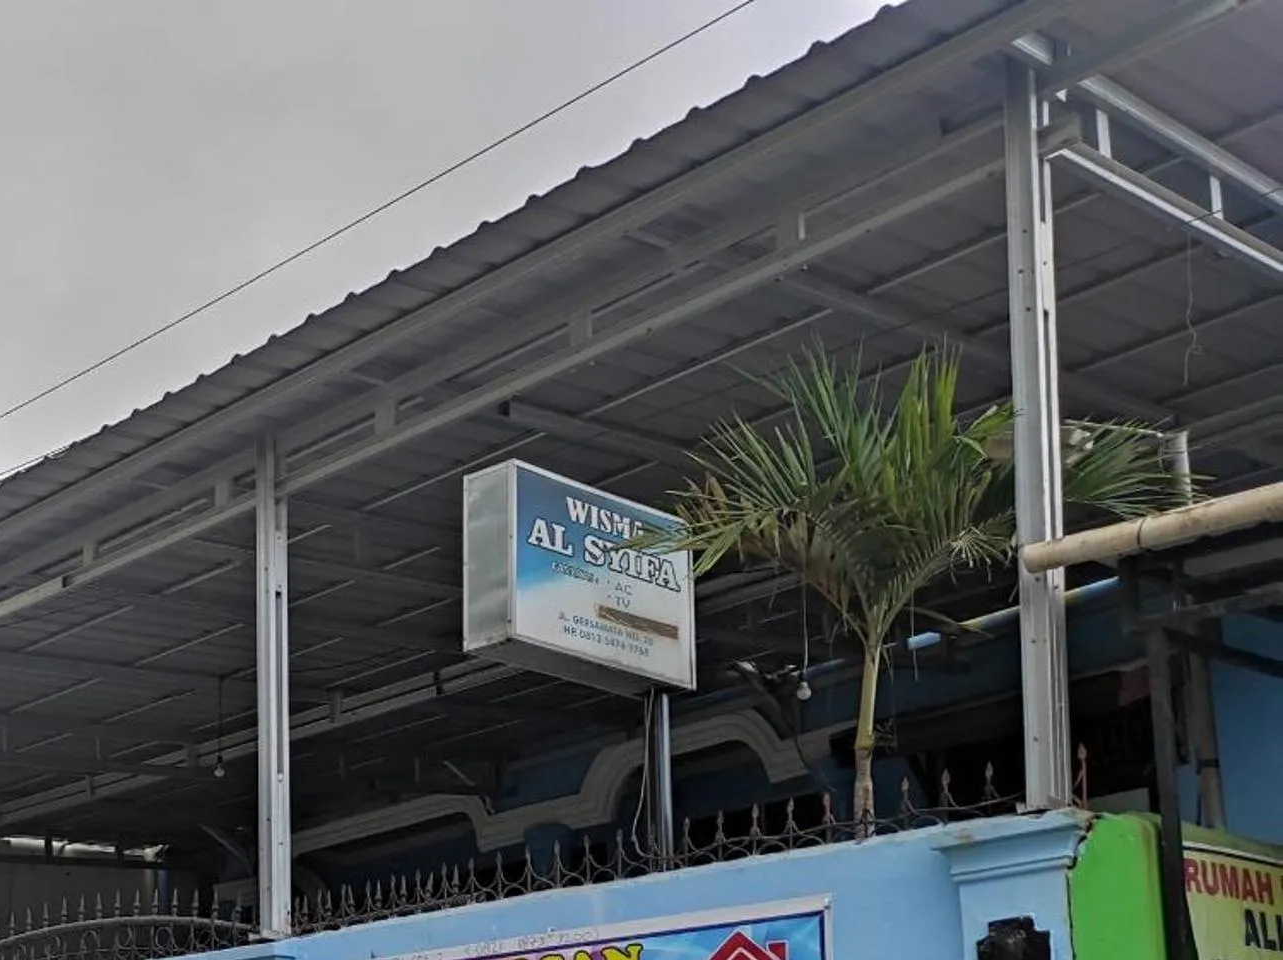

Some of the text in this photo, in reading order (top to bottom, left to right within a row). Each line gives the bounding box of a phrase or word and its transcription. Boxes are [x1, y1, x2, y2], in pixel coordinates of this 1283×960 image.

[527, 516, 575, 557] AL
[584, 534, 682, 592] SYIFA
[1185, 857, 1275, 906] RUMAH
